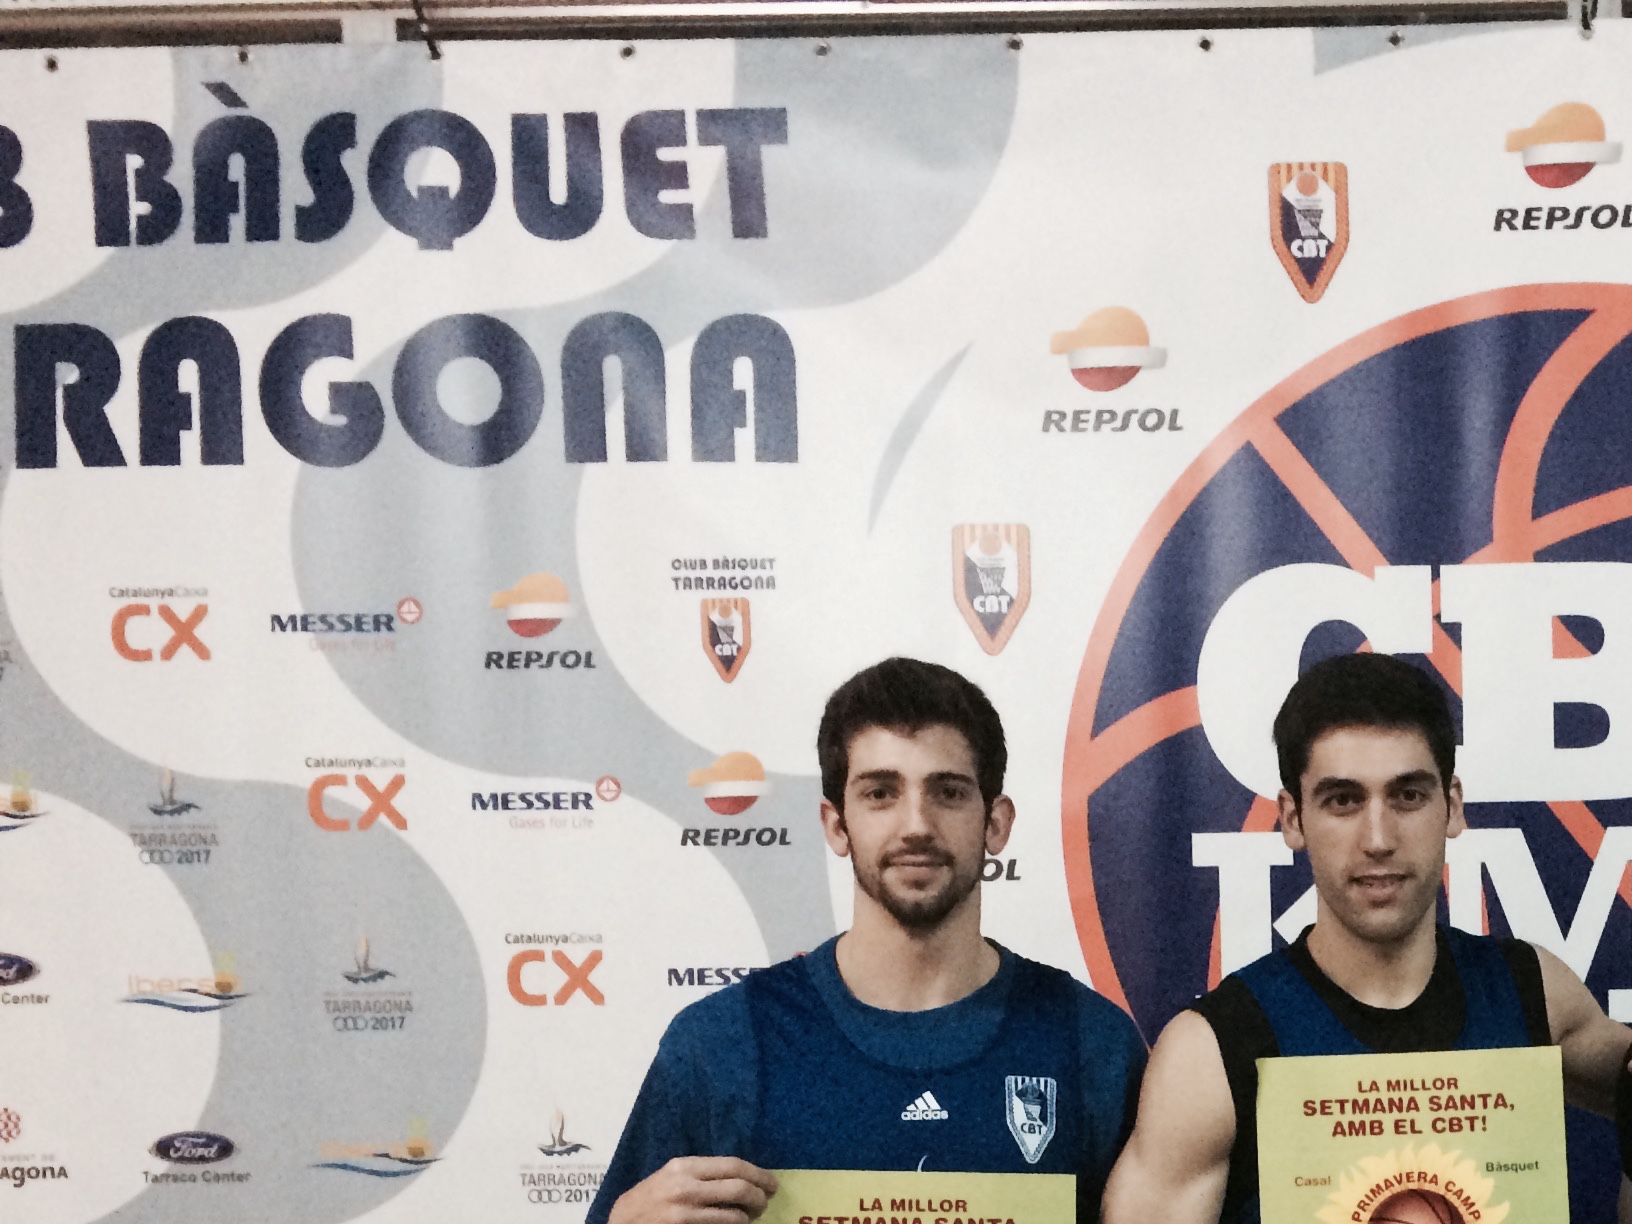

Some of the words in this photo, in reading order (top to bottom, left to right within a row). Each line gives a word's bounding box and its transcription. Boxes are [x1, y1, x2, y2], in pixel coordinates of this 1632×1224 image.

[86, 81, 788, 250] BÀSQUET
[1041, 408, 1184, 432] REPSOL
[671, 558, 708, 571] CLUB
[671, 576, 776, 591] TARRAGONA
[110, 604, 211, 662] CX
[270, 613, 395, 633] MESSER
[485, 650, 596, 670] REPSOL
[307, 774, 408, 831] CX
[471, 791, 594, 811] MESSER
[681, 827, 791, 848] REPSOL
[506, 950, 605, 1006] CX
[371, 1016, 405, 1031] 2017
[1357, 1080, 1380, 1093] LA
[1387, 1077, 1458, 1092] MILLOR
[901, 1109, 948, 1120] adidas
[1303, 1096, 1420, 1116] SETMANA
[1429, 1093, 1515, 1112] SANTA,
[1020, 1123, 1043, 1135] CBT
[1332, 1118, 1384, 1137] AMB
[1393, 1118, 1423, 1134] EL
[1431, 1115, 1487, 1133] CBT!
[1486, 1160, 1539, 1174] Bàsquet
[1294, 1175, 1331, 1187] Casal
[859, 1198, 882, 1212] LA
[890, 1199, 968, 1213] MILLOR
[1351, 1171, 1439, 1223] PRIMAVERA
[1444, 1179, 1481, 1222] CAMP
